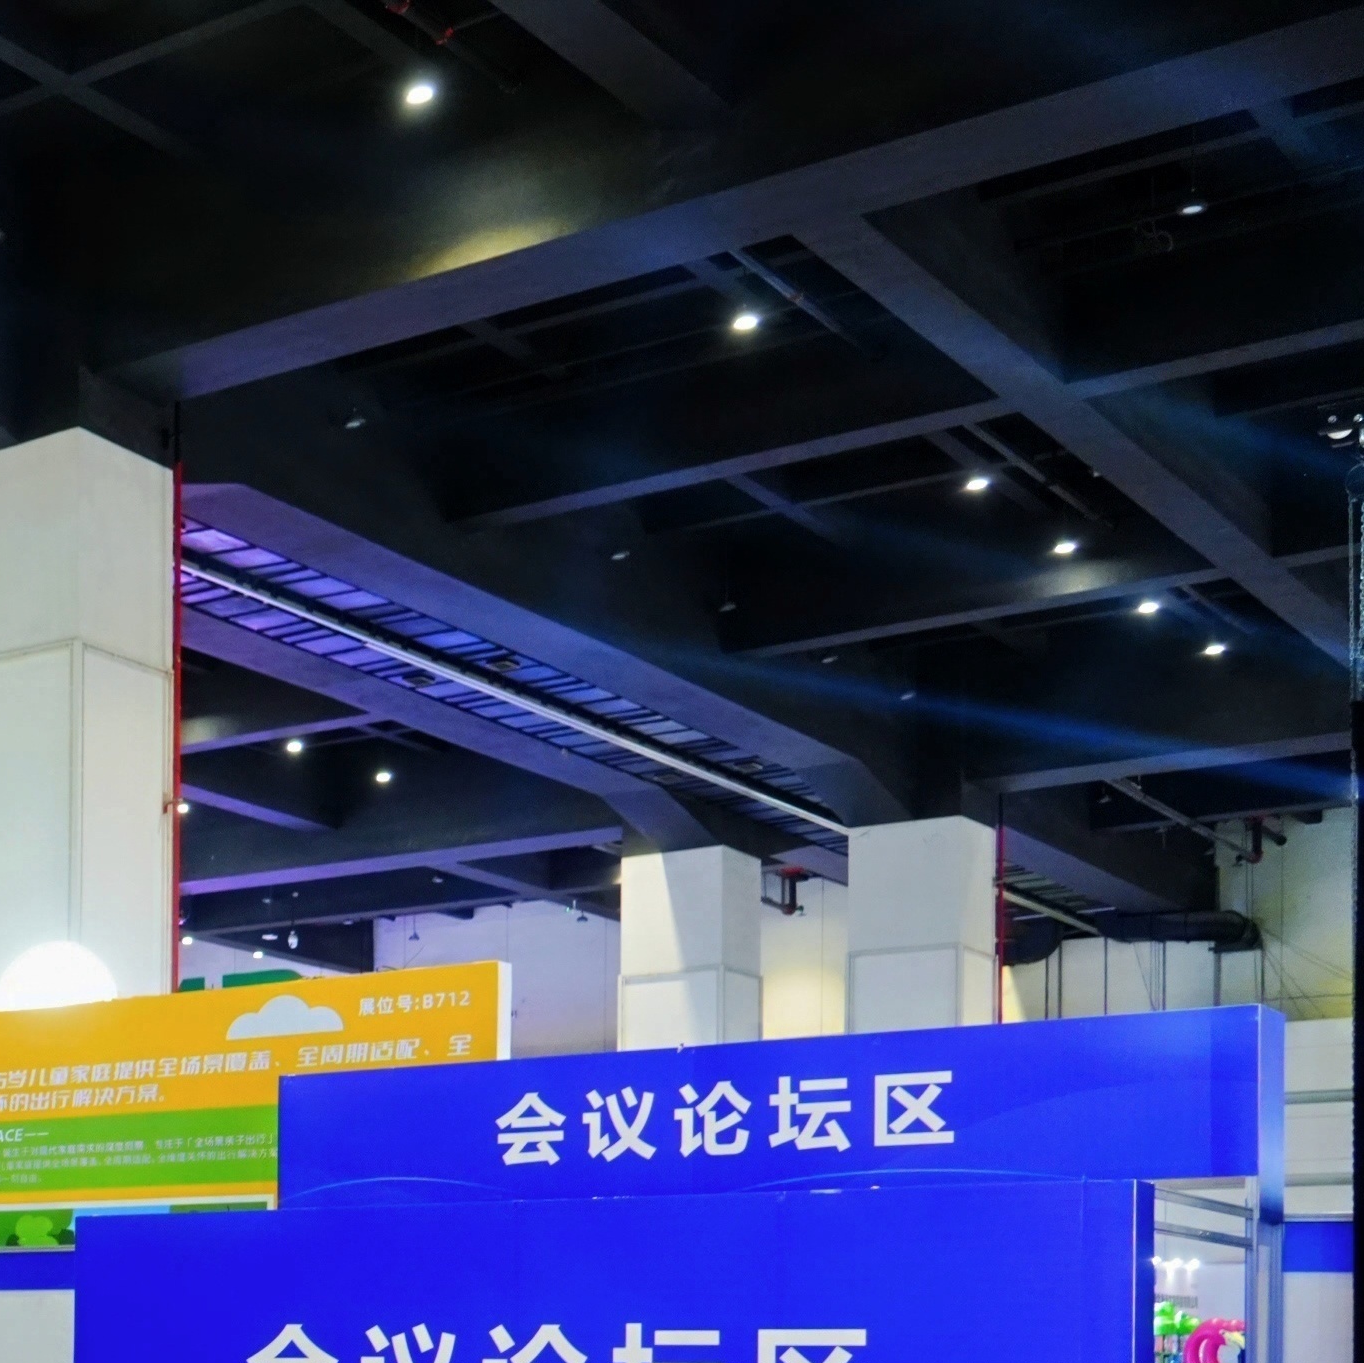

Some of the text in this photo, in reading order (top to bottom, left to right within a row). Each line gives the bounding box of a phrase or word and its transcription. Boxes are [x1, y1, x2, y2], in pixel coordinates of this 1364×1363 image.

[495, 1070, 955, 1166] 会议论坛区
